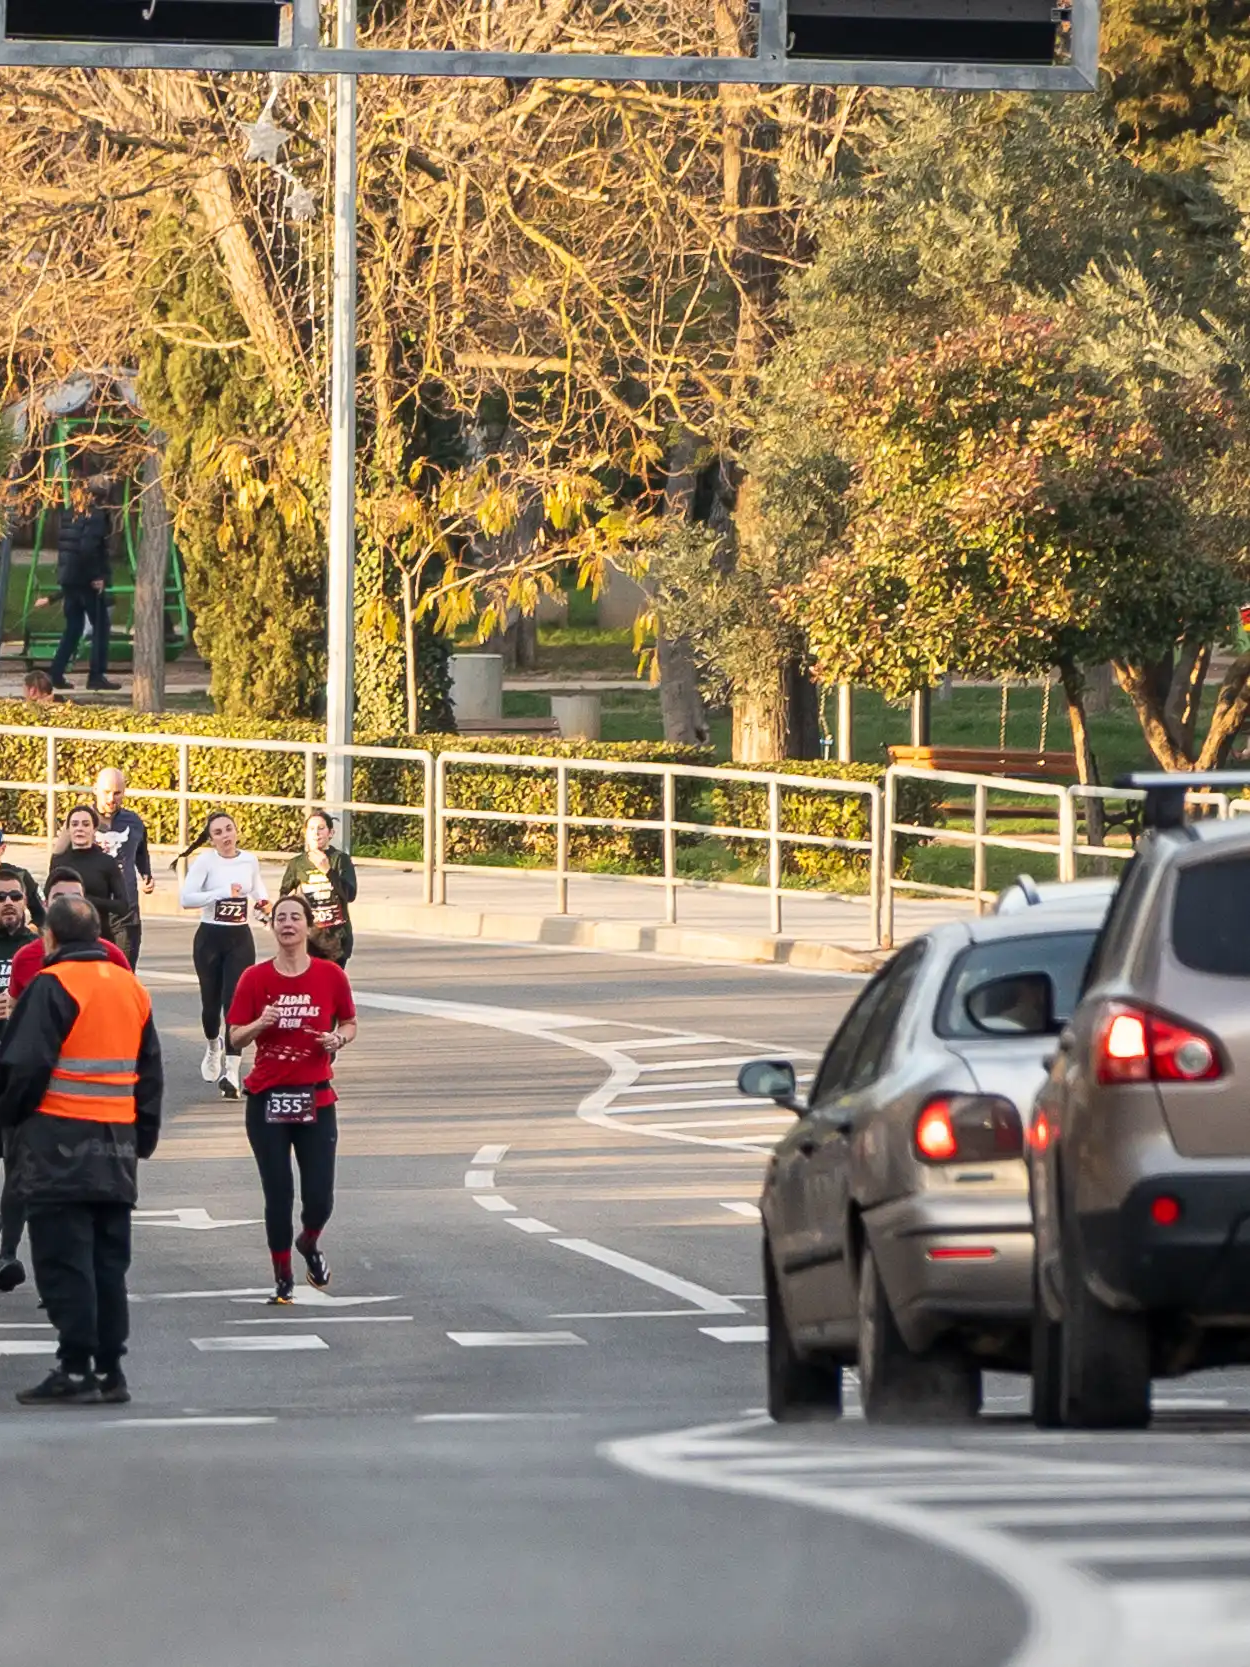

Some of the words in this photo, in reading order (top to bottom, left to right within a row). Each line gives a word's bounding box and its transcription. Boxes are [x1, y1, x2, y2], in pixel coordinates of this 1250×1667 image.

[219, 905, 242, 917] 272
[278, 994, 311, 1006] ZADAR
[278, 1017, 302, 1029] RUN
[271, 1098, 303, 1113] 355
